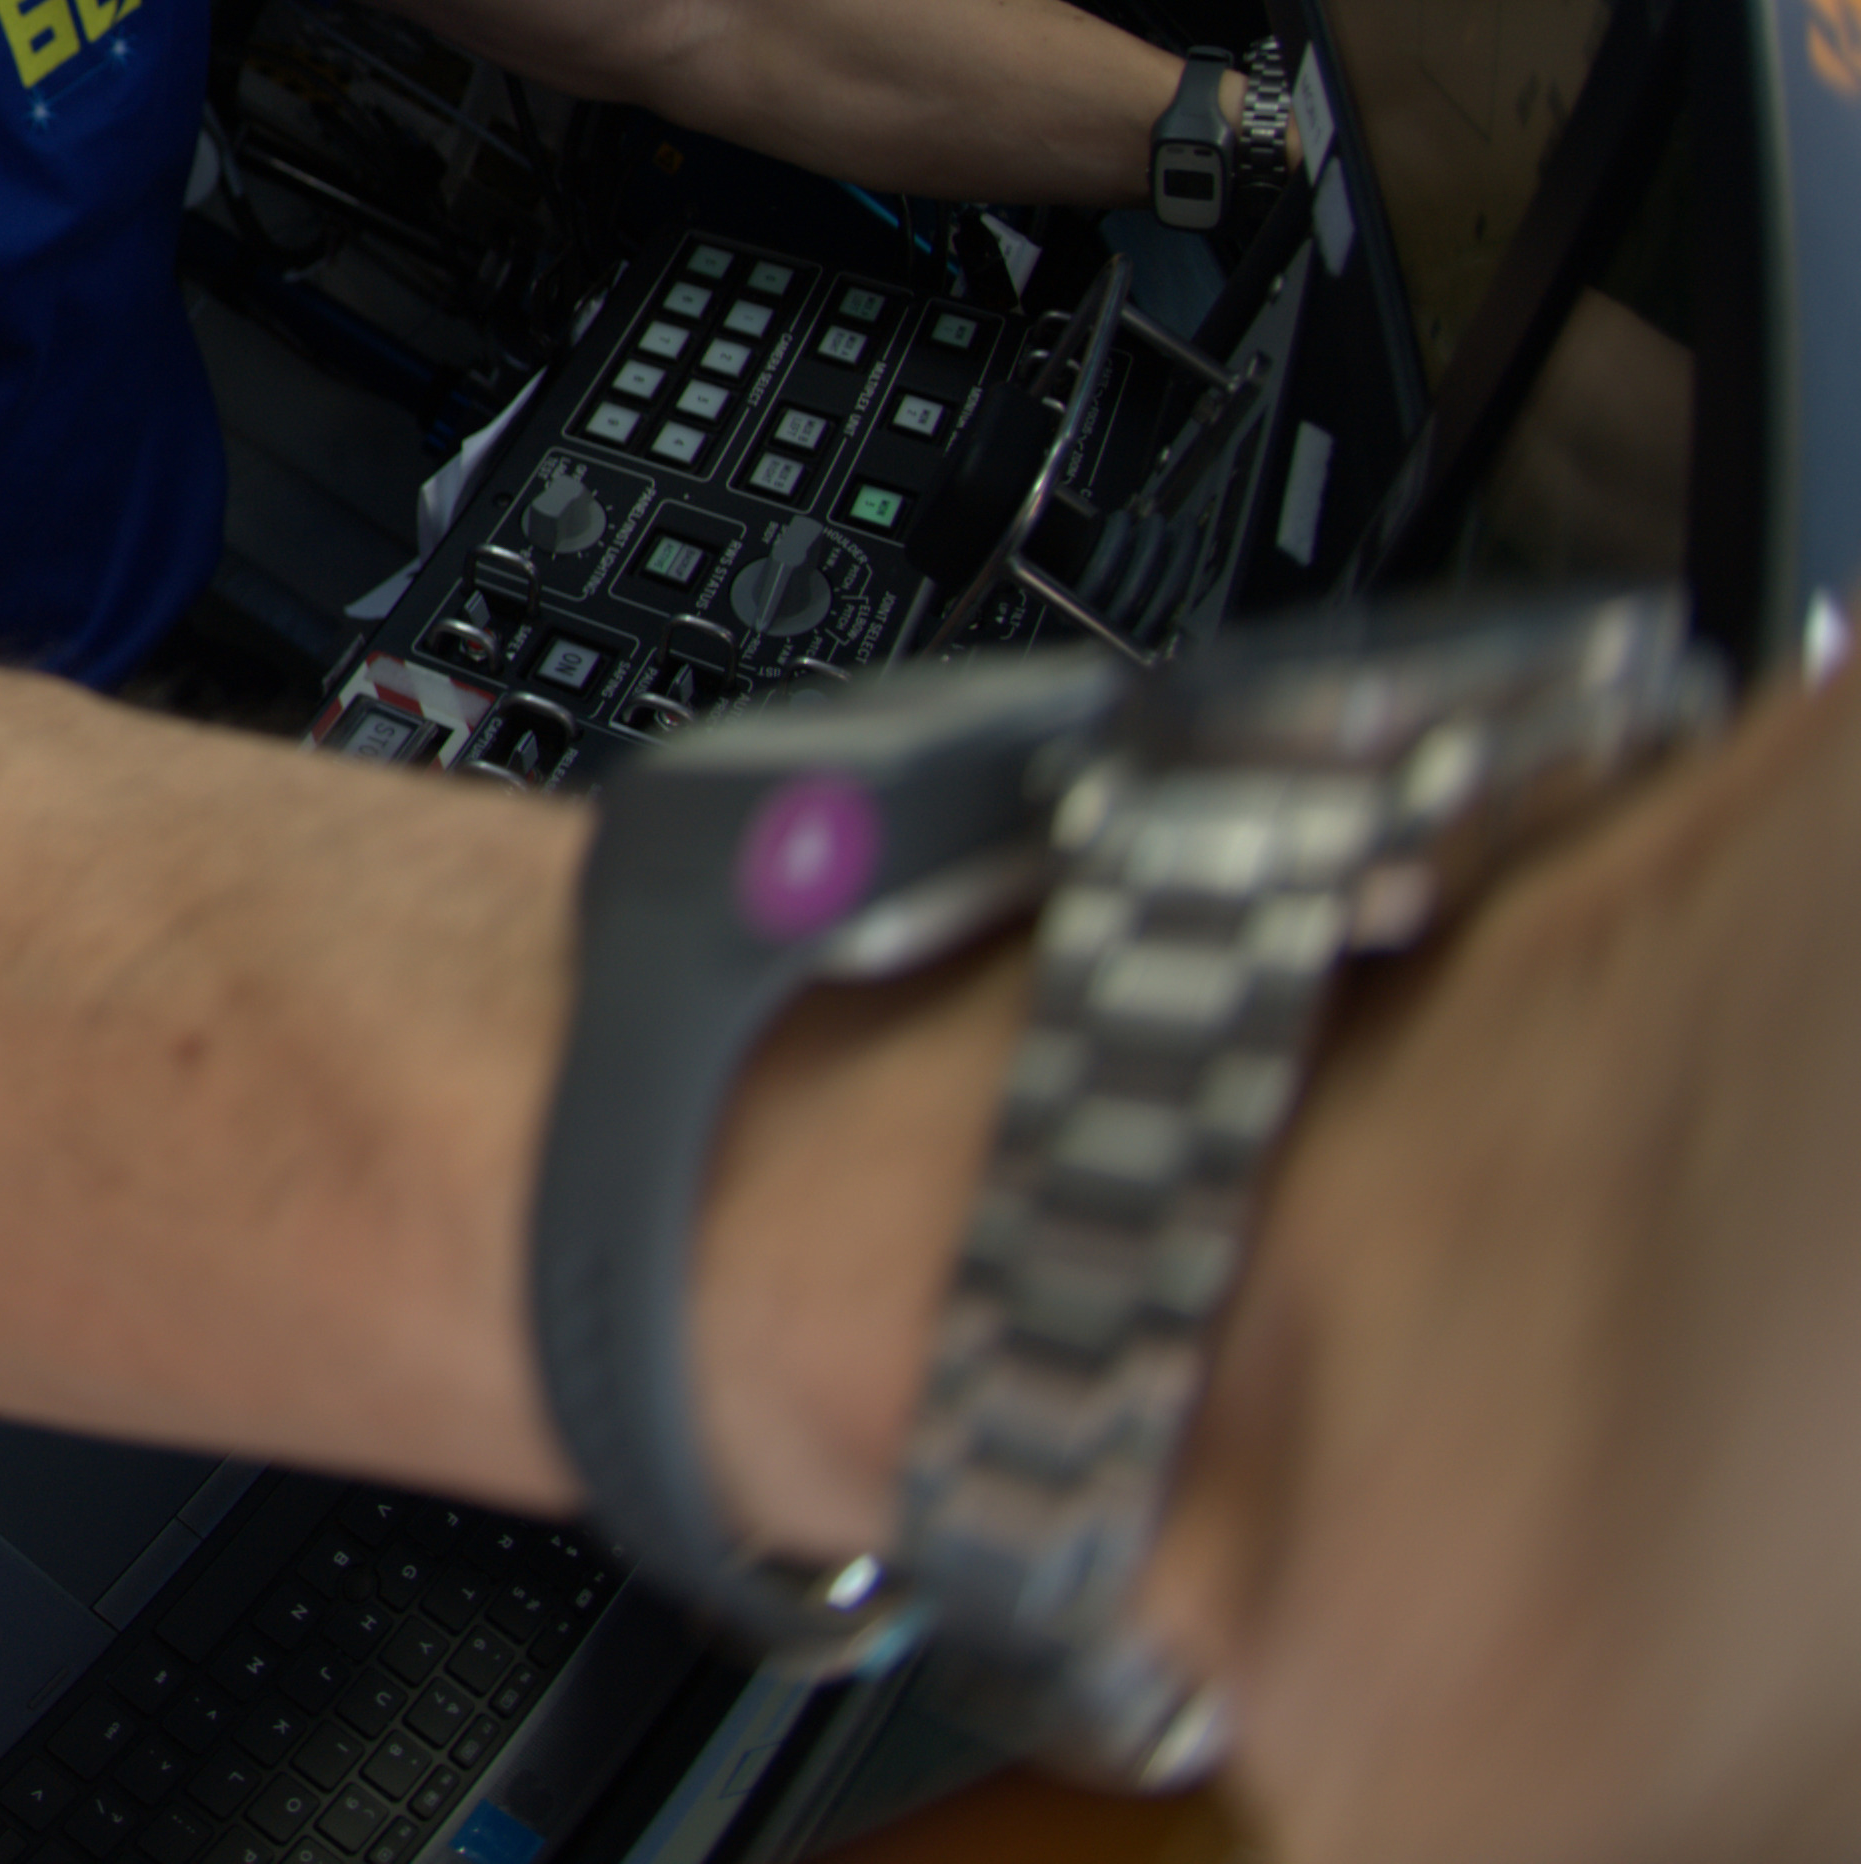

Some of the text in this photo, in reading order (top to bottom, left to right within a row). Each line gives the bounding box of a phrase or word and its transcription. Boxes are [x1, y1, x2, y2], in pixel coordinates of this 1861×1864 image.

[744, 330, 795, 408] CAMERA SELECT
[840, 358, 888, 438] MULTIPLEX UNIT
[580, 543, 620, 596] LIGHTING
[693, 536, 744, 612] RWS STATUS
[833, 602, 856, 632] PITCH
[844, 602, 873, 642] ELBOW
[1007, 604, 1027, 630] TILT
[853, 588, 899, 666] JOINT SELECT
[508, 622, 532, 653] SAFE
[802, 633, 825, 662] PITC
[552, 649, 584, 680] ON
[599, 657, 631, 701] SAFING
[463, 714, 503, 763] CAPTUR
[378, 1503, 392, 1518] V
[447, 1511, 459, 1527] F
[498, 1534, 514, 1549] R
[333, 1551, 349, 1566] B
[401, 1564, 417, 1580] G
[461, 1587, 475, 1600] T
[290, 1603, 308, 1621] N
[360, 1614, 378, 1631] H
[418, 1641, 434, 1655] Y
[245, 1656, 265, 1674] M
[320, 1667, 331, 1680] J
[375, 1691, 391, 1706] U
[434, 1691, 446, 1704] 7
[273, 1719, 291, 1734] K
[389, 1743, 403, 1756] 8
[228, 1770, 245, 1783] L
[286, 1797, 302, 1813] O
[244, 1848, 257, 1864] P
